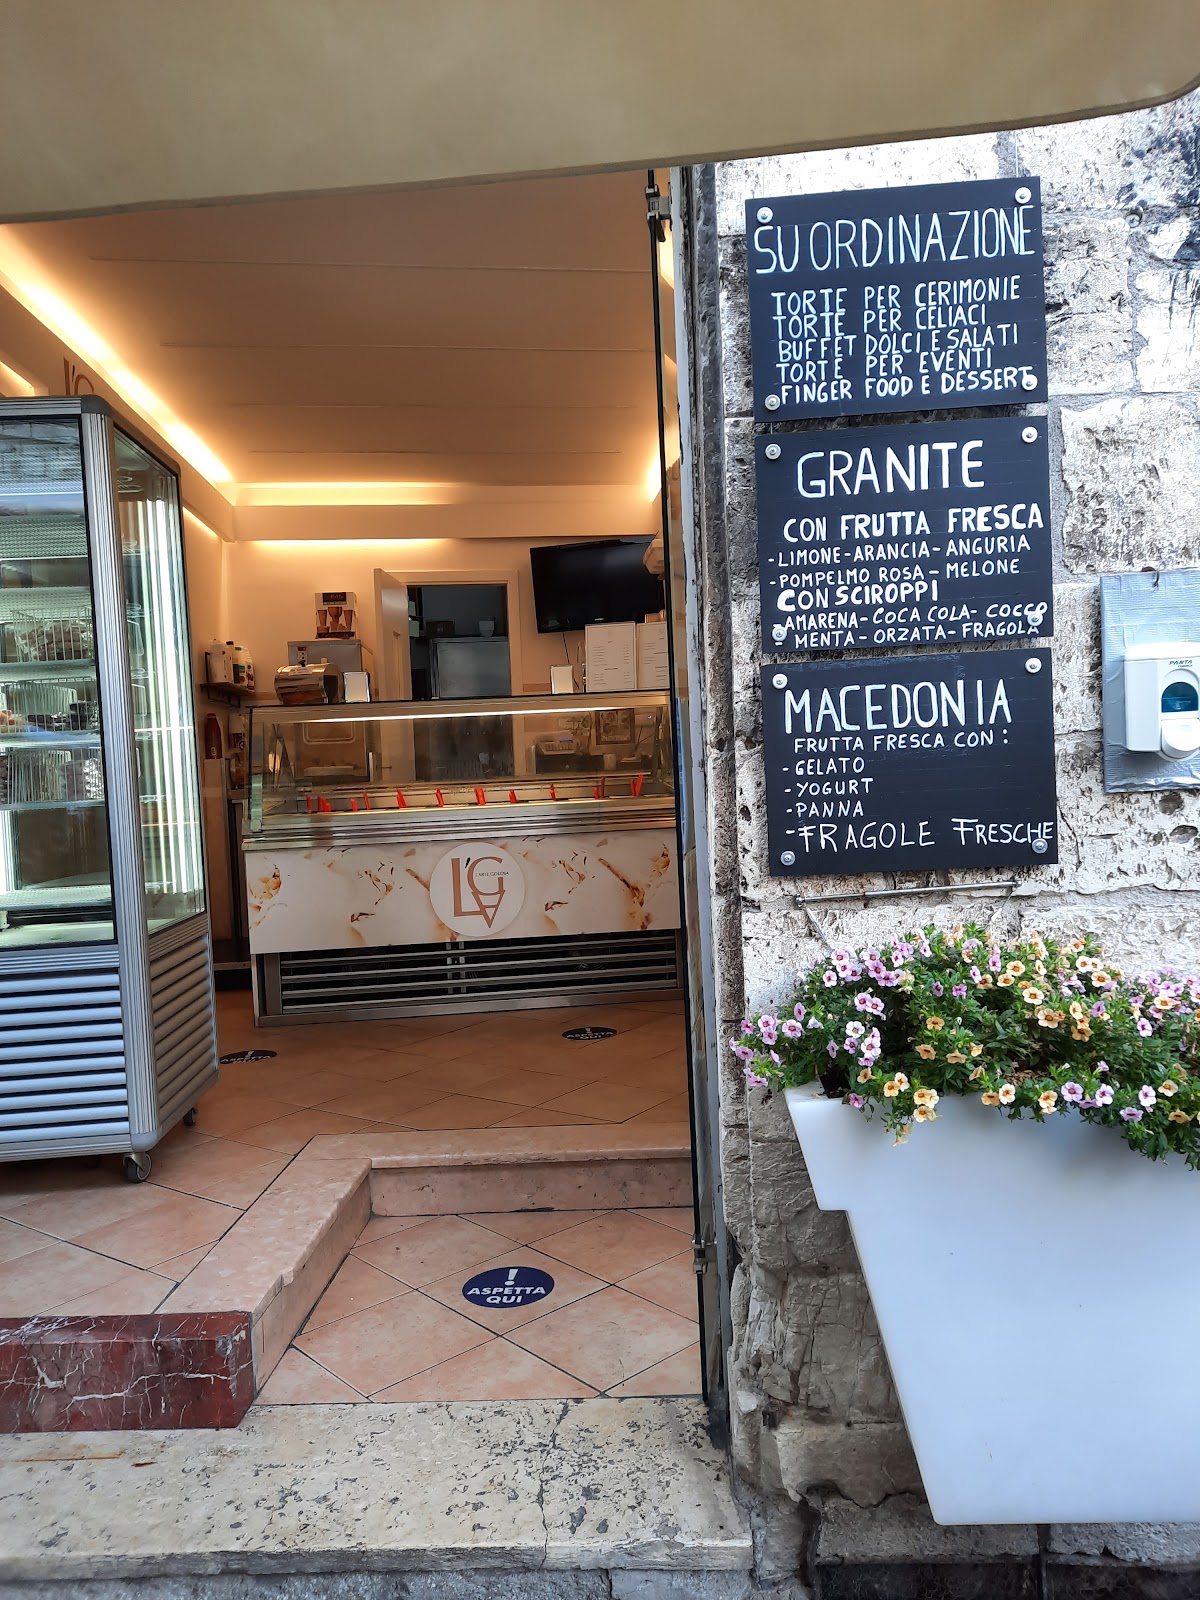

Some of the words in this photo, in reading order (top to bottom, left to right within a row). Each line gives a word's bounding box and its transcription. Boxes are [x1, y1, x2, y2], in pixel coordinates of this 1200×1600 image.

[754, 224, 799, 274] SU
[809, 204, 1035, 271] ORDINAZIONE
[771, 288, 848, 316] TORTE
[864, 284, 900, 309] PER
[915, 274, 1021, 308] CERIMONIE
[773, 312, 845, 338] TORTE
[863, 309, 902, 333] PER
[916, 303, 986, 330] CELIACI
[778, 335, 857, 363] BUFFET
[865, 332, 921, 355] DOLCI
[932, 330, 941, 349] E
[948, 323, 1018, 348] SALATI
[776, 358, 843, 383] TORTE
[865, 354, 903, 377] PER
[919, 347, 992, 373] EVENTI
[781, 379, 852, 405] FINGER
[866, 376, 913, 398] FOOD
[921, 375, 930, 394] E
[942, 366, 1033, 393] DESSERT
[797, 440, 984, 498] GRANITE
[783, 517, 827, 542] CON
[841, 510, 930, 540] FRUTTA
[948, 503, 1044, 533] FRESCA
[879, 565, 924, 581] ROSA
[947, 559, 1020, 579] MELONE
[777, 587, 828, 611] CON
[836, 579, 938, 605] SCIROPPI
[872, 607, 921, 625] COCA
[986, 602, 1048, 618] COCCO
[794, 631, 855, 648] MENTA
[784, 679, 1012, 734] MACEDONIA
[794, 737, 864, 753] FRUTTA
[873, 733, 944, 750] FRESCA
[954, 730, 993, 747] CON
[951, 818, 1053, 846] FRESCHE
[467, 1287, 546, 1295] ASPETTA
[486, 1296, 522, 1304] QUI
